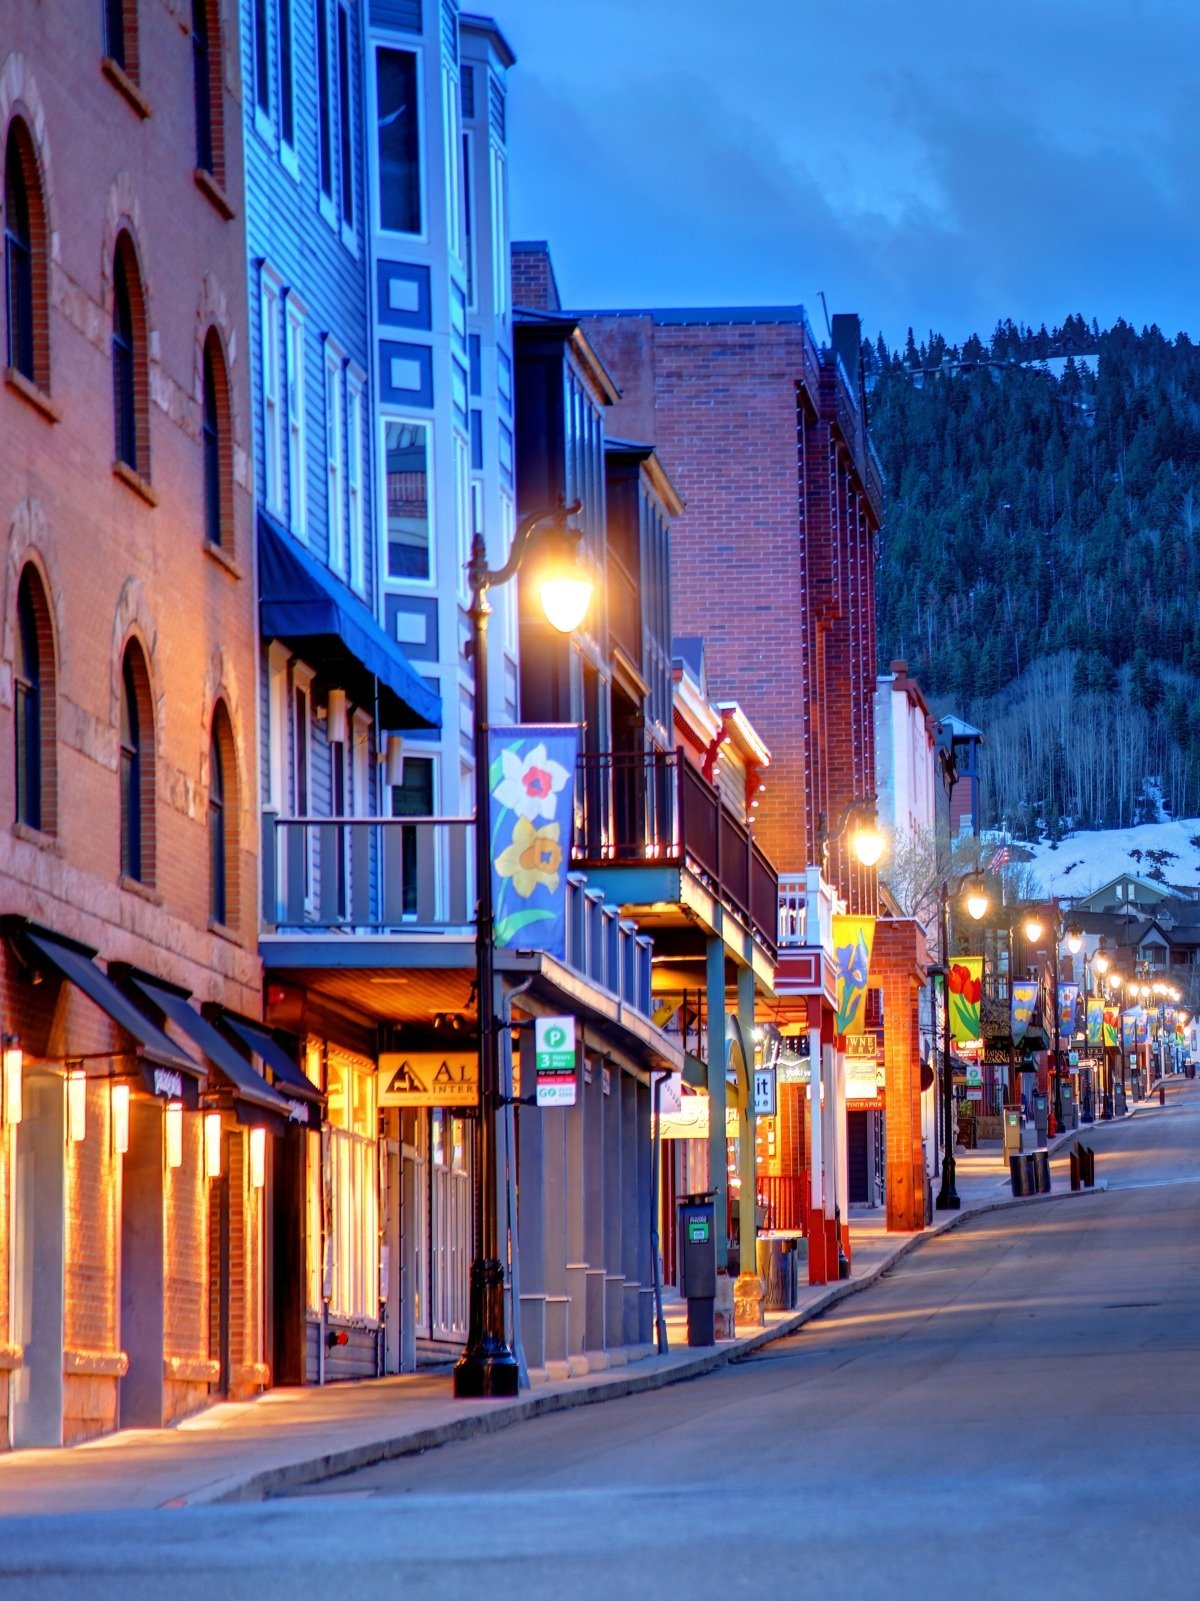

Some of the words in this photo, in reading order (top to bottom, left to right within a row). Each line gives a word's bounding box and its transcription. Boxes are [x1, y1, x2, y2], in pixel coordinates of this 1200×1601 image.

[846, 1037, 873, 1046] WNE
[541, 1054, 550, 1068] 3
[432, 1085, 474, 1094] INTER
